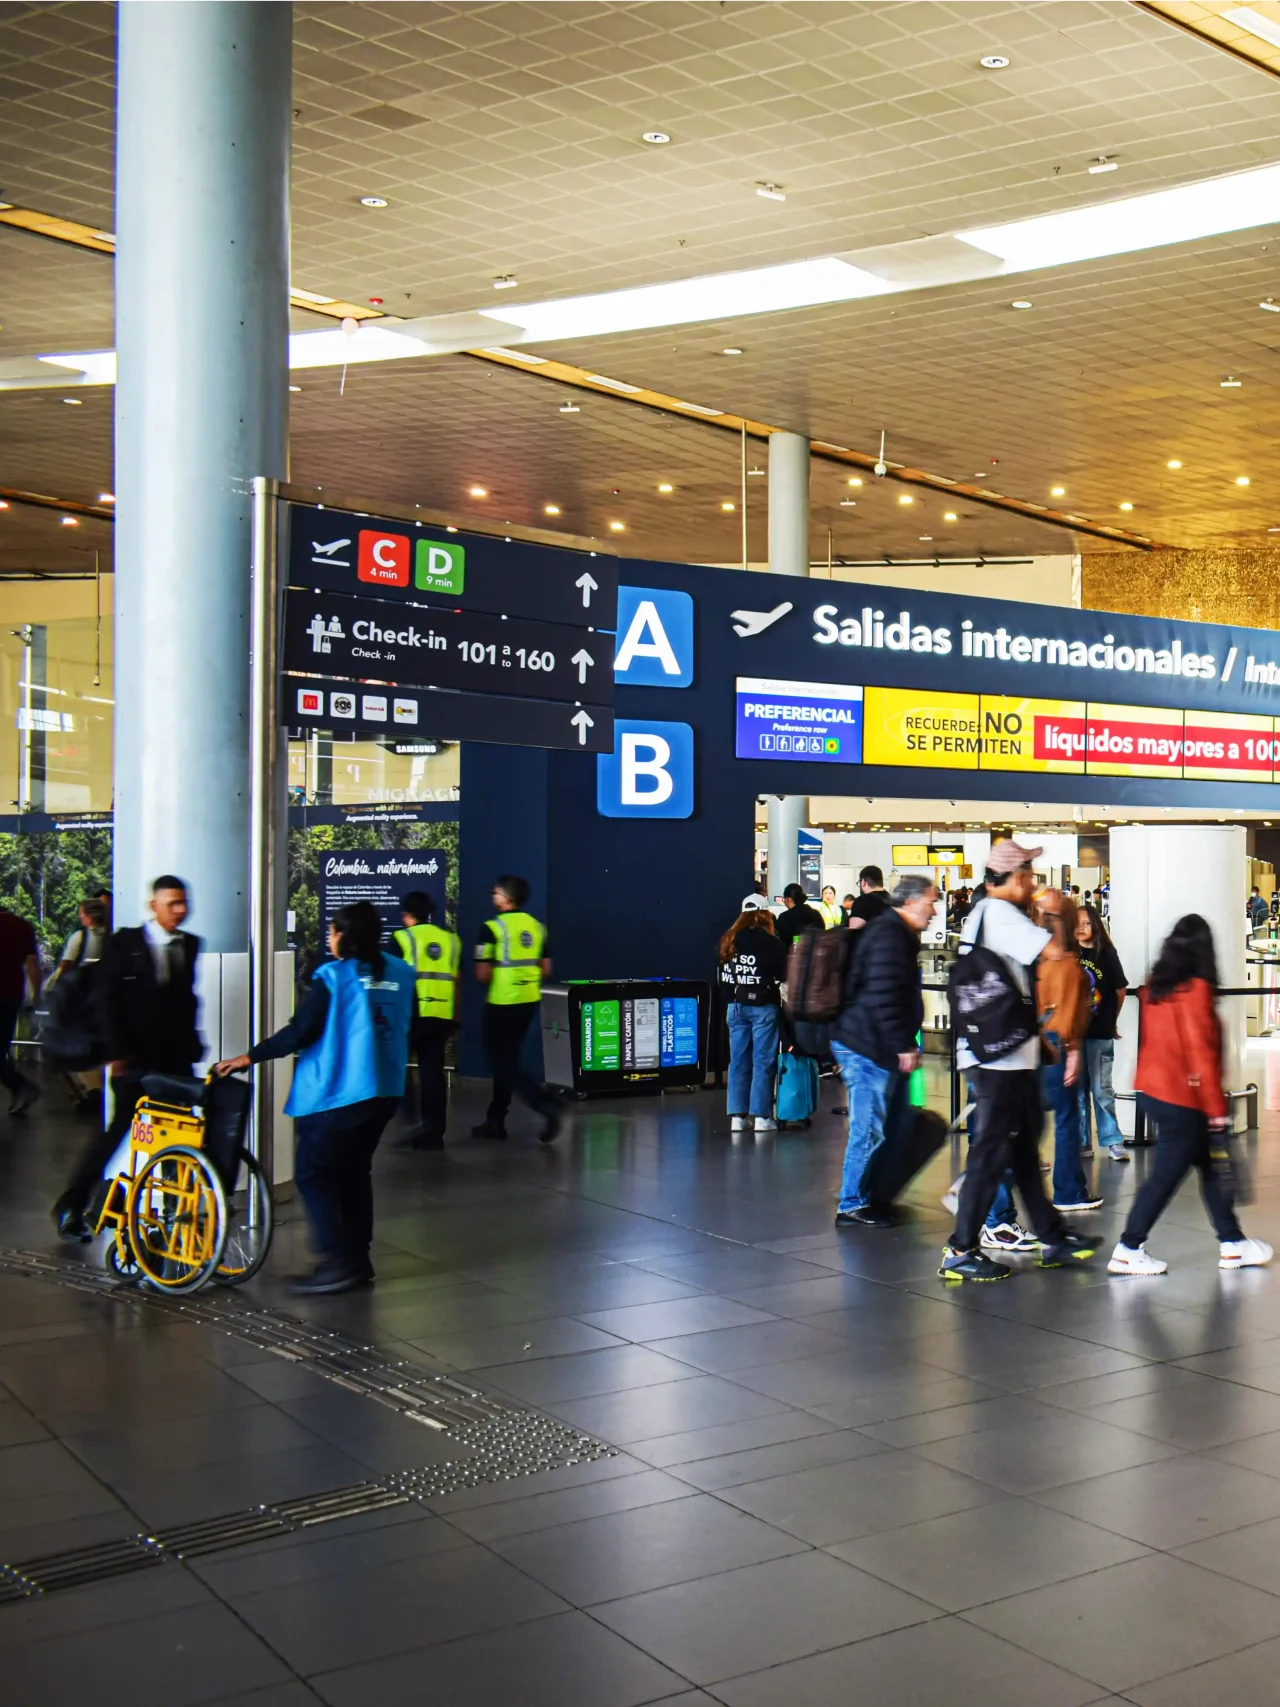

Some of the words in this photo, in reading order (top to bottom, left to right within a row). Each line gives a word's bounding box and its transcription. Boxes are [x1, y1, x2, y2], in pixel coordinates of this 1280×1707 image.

[373, 539, 396, 568] C
[428, 547, 453, 575] D
[370, 567, 377, 576] 4
[379, 570, 398, 579] min
[426, 575, 433, 584] 9
[435, 578, 453, 588] min
[352, 620, 447, 650] Check-in
[614, 601, 681, 675] A
[812, 603, 953, 655] Salidas
[962, 620, 1217, 682] internacionales
[1221, 647, 1238, 682] /
[351, 647, 381, 660] Check
[457, 641, 497, 665] 101
[515, 648, 555, 672] 160
[502, 659, 512, 668] to
[744, 703, 856, 724] PREFERENCIAL
[906, 716, 981, 733] RECUERDE:
[986, 712, 1022, 735] NO
[772, 723, 812, 733] Preference
[813, 726, 828, 734] row
[396, 744, 437, 754] SAMSUNG
[906, 734, 927, 751] SE
[932, 736, 1021, 755] PERMITEN
[1045, 725, 1134, 757] líquidos
[1137, 737, 1225, 762] mayores
[1228, 743, 1239, 759] a
[621, 732, 674, 805] B
[377, 858, 439, 876] naturalmente
[724, 963, 757, 975] HPPY
[740, 955, 756, 965] SO
[737, 975, 761, 984] MET
[132, 1121, 154, 1144] 065
